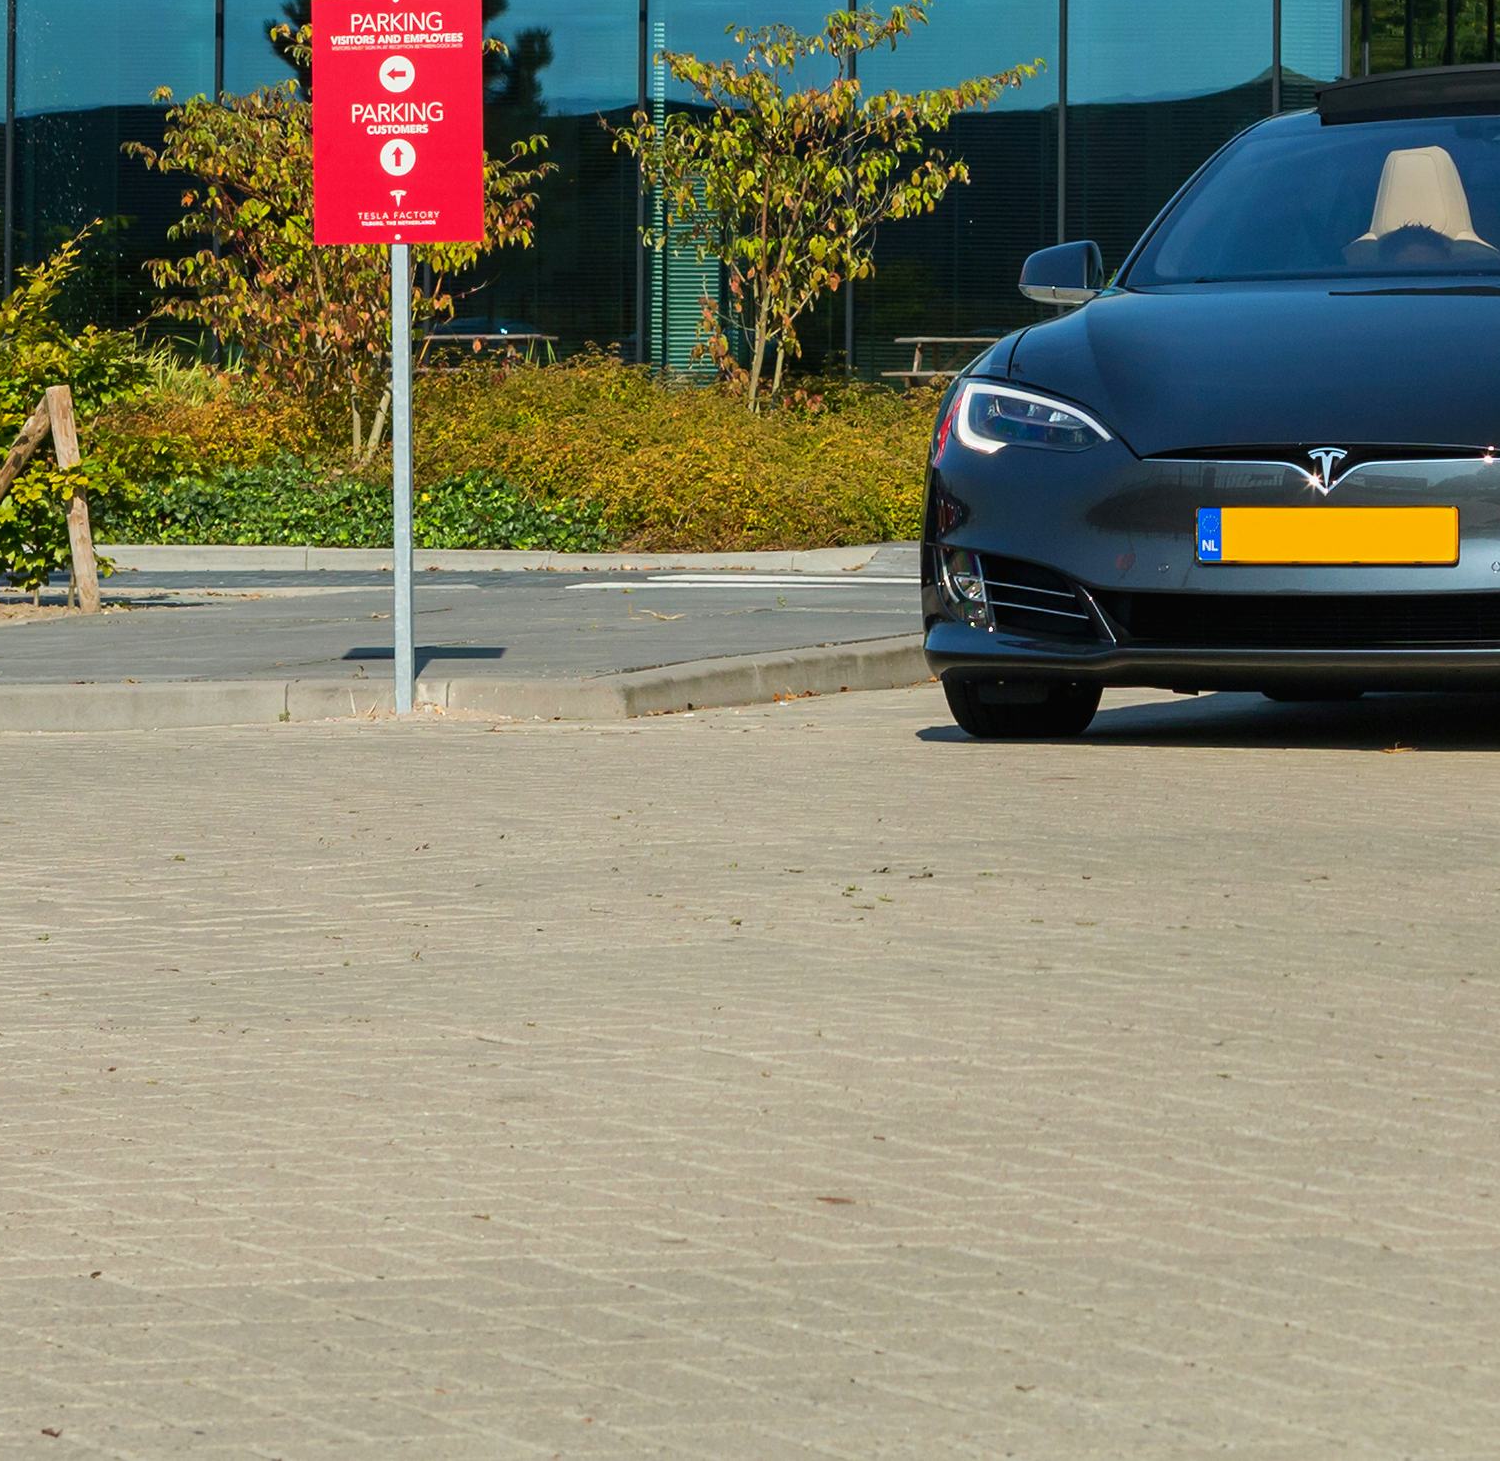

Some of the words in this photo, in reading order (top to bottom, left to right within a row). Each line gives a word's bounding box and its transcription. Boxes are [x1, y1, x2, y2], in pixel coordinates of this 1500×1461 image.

[350, 11, 443, 32] PARKING
[330, 35, 375, 45] VISITORS
[377, 34, 401, 44] AND
[403, 32, 464, 43] EMPLOYEES
[351, 101, 444, 123] PARKING
[366, 124, 429, 135] CUSTOMERS
[357, 212, 389, 220] TESLA
[393, 211, 440, 219] FACTORY
[1202, 539, 1219, 552] NL
